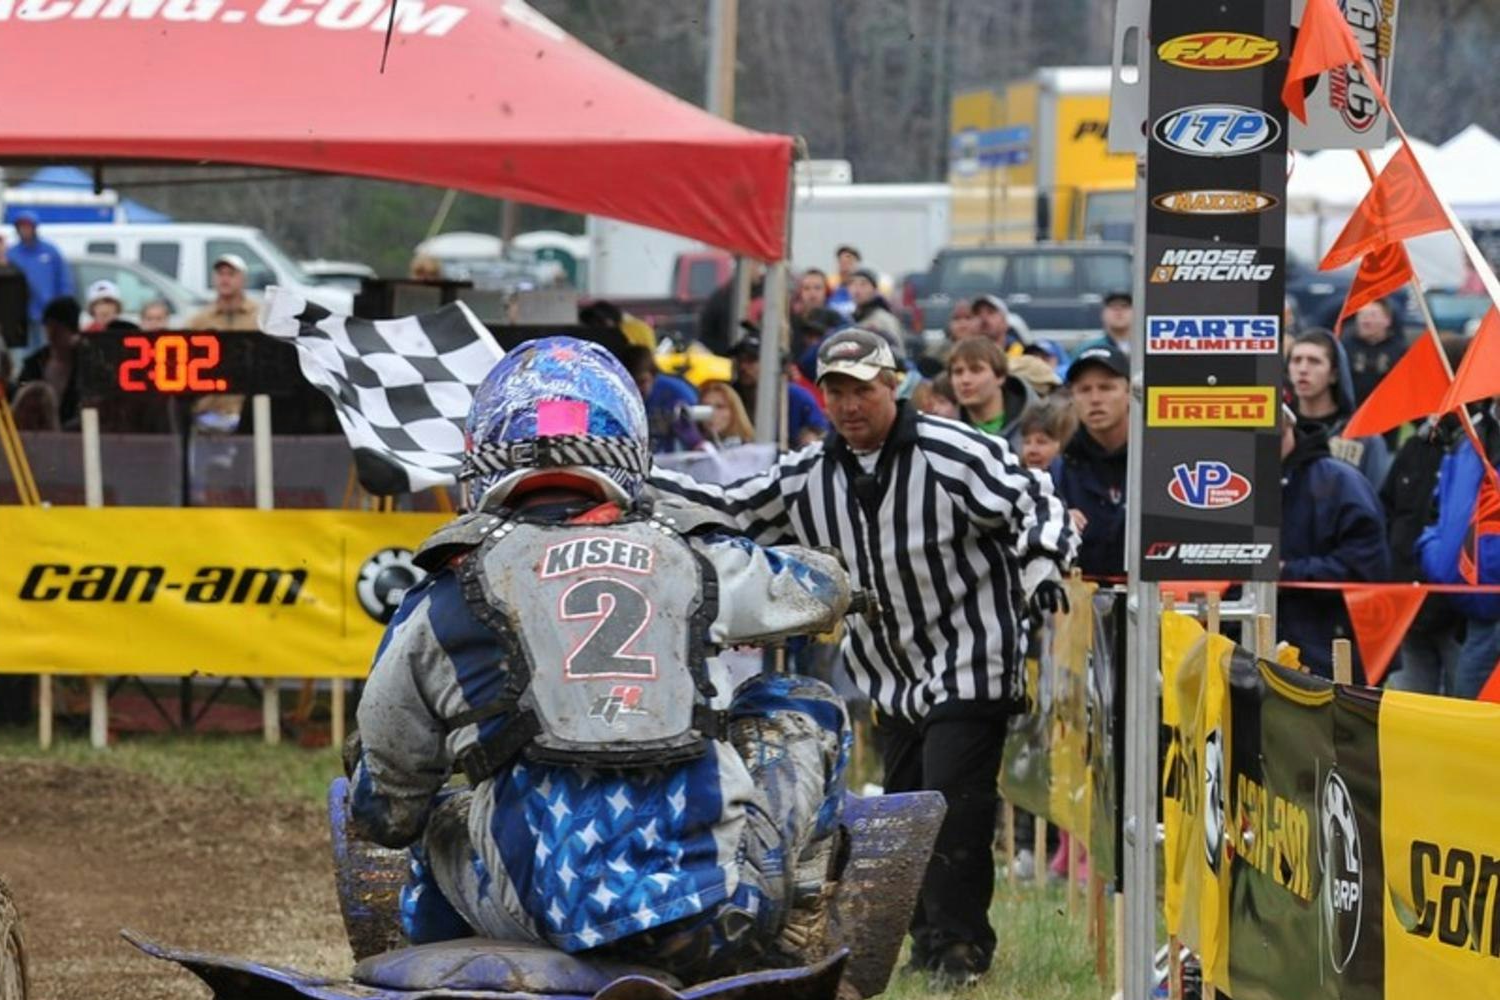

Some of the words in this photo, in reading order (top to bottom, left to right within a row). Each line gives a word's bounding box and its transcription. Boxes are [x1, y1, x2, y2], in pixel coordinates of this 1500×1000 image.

[1159, 38, 1279, 61] FMF
[1167, 114, 1266, 147] ITP
[1161, 249, 1257, 266] MOOSE
[1172, 265, 1275, 281] RACING
[1149, 319, 1276, 338] PARTS
[1150, 338, 1276, 351] UNLIMITED
[1156, 394, 1269, 420] PIRELLI
[1172, 460, 1232, 506] VP
[543, 538, 653, 578] KISER
[1178, 543, 1273, 559] WISECO
[17, 563, 309, 605] can-am
[558, 577, 658, 680] 2
